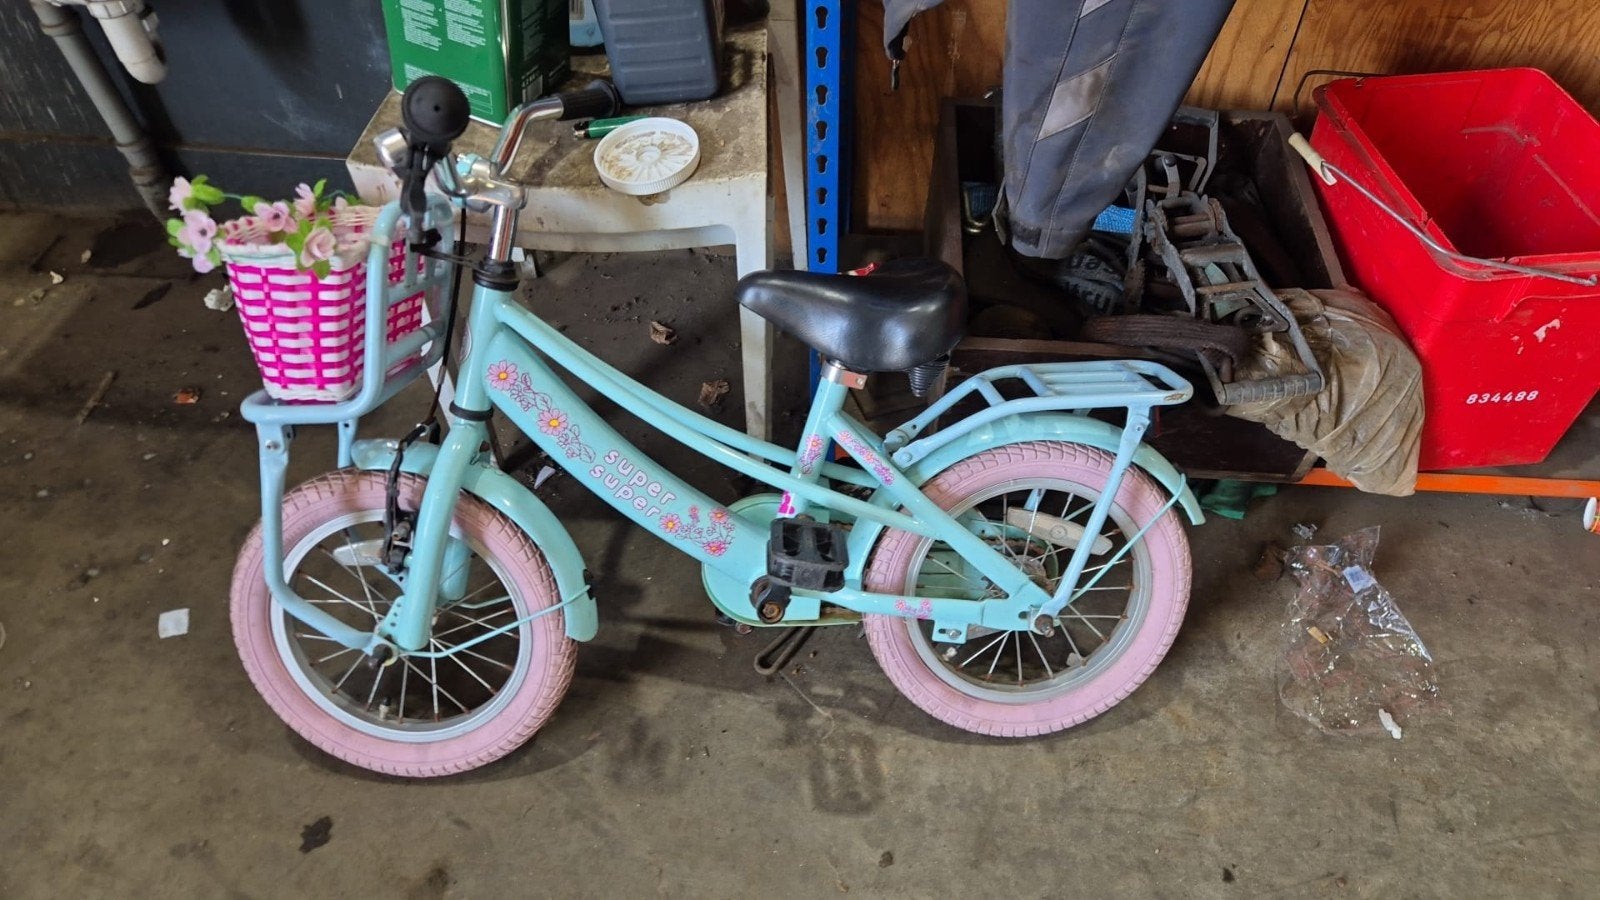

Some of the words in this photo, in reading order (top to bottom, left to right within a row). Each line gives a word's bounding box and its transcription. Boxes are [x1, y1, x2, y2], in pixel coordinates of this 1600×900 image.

[1466, 390, 1539, 405] 834488
[590, 465, 661, 518] super
[605, 450, 676, 505] super
